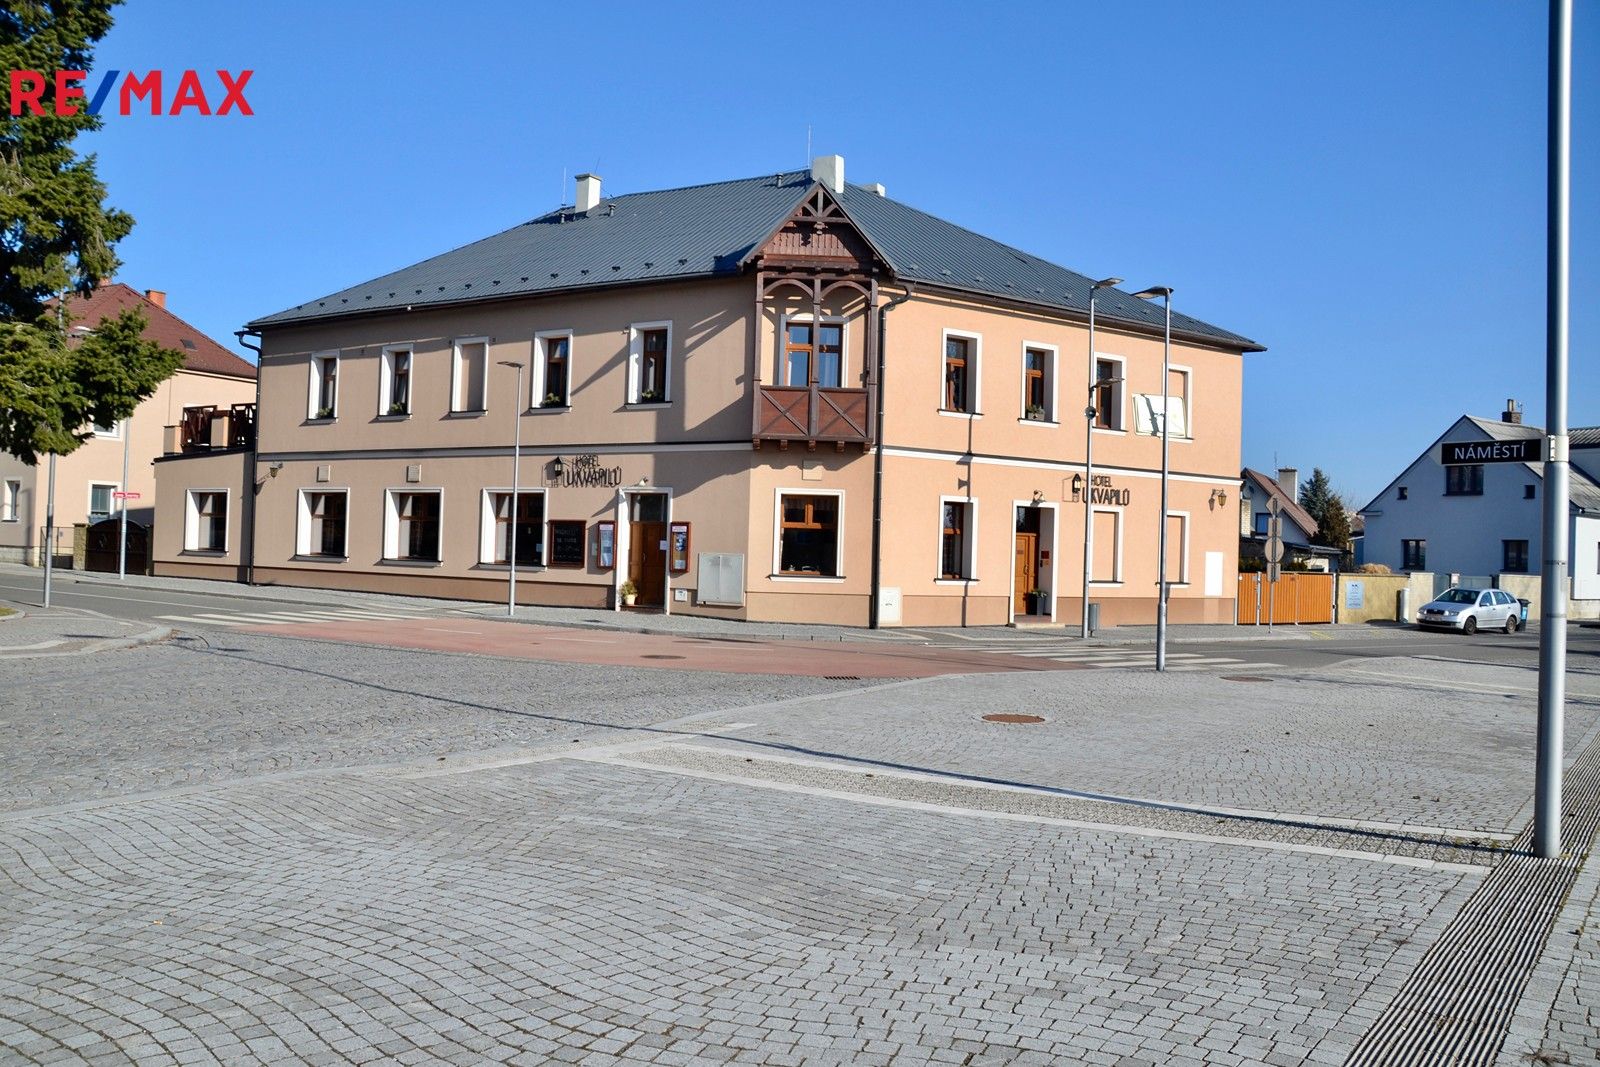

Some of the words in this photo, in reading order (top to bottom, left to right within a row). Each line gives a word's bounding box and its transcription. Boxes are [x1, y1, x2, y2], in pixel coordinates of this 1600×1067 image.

[1454, 441, 1526, 460] NÁMĚSTÍ
[574, 454, 601, 467] HOTEL
[1090, 474, 1112, 487] HOTEL
